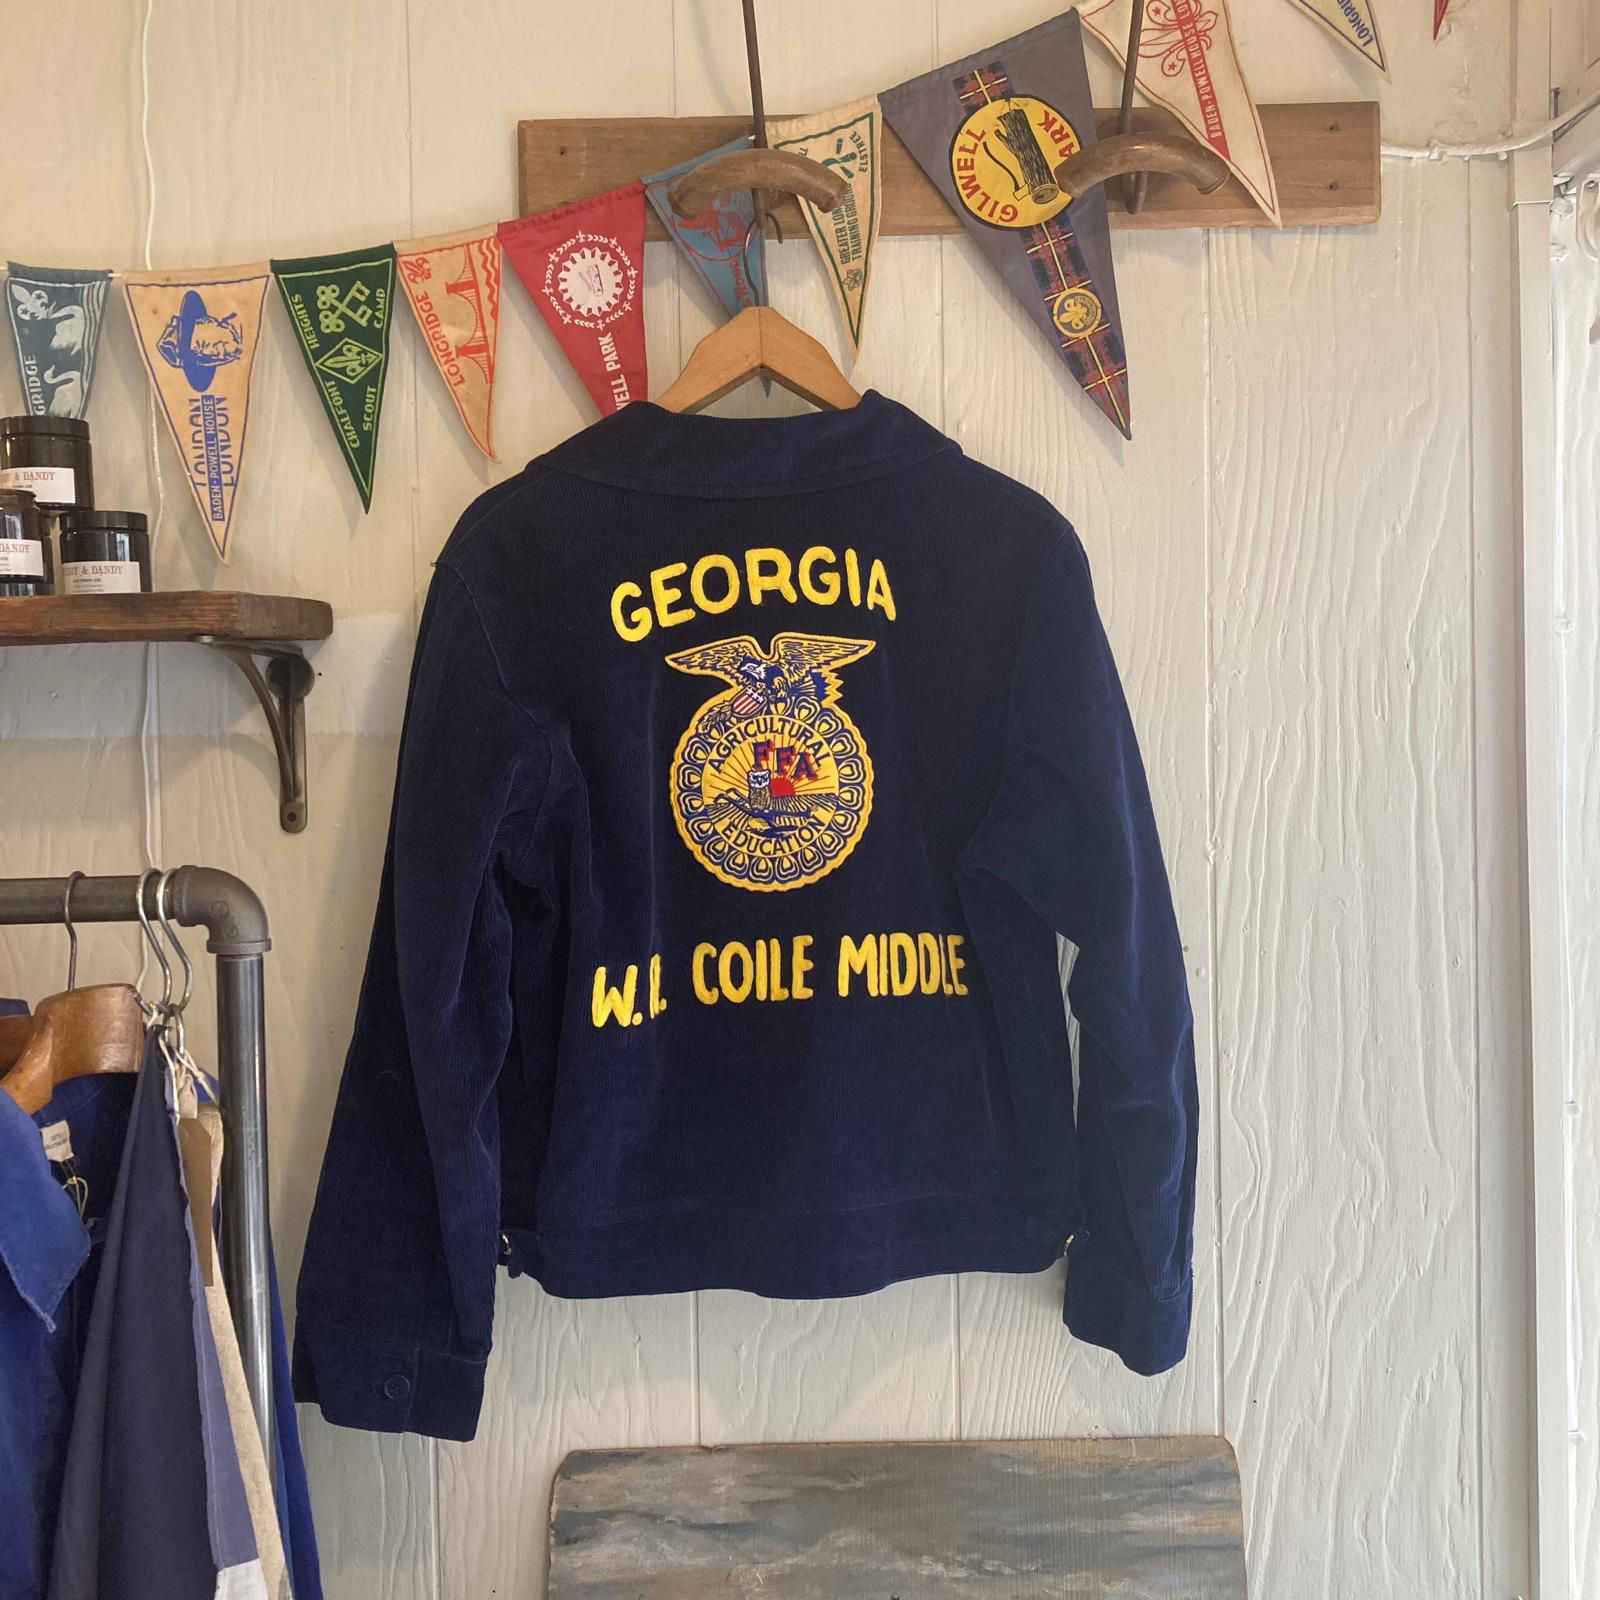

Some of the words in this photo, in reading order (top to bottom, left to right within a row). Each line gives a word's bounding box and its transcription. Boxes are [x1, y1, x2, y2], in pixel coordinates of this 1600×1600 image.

[1182, 21, 1202, 58] HOUSE
[1337, 0, 1375, 47] LONGRI
[849, 131, 868, 173] ELSTREE
[957, 128, 1018, 222] GILWELL
[1037, 110, 1075, 159] ARK
[831, 207, 845, 228] LON
[835, 228, 850, 265] GREATER
[847, 219, 862, 261] TRAINING
[291, 293, 320, 350] HEIGHTS
[415, 290, 465, 387] LONGRIDGE
[362, 385, 377, 432] SCOUT
[373, 288, 386, 329] CAMP
[597, 331, 621, 371] PARK
[24, 354, 46, 416] GRIDGE
[203, 397, 217, 433] HOUSE
[324, 380, 361, 449] CHALFONT
[23, 471, 56, 480] DANDY
[91, 565, 124, 575] DANDY
[610, 545, 897, 642] GEORGIA
[708, 717, 831, 775] AGRICULTURAL
[752, 739, 818, 782] FFA
[721, 815, 826, 856] EDUCATION
[692, 934, 814, 1005] COILE
[838, 932, 969, 997] MIDDLE
